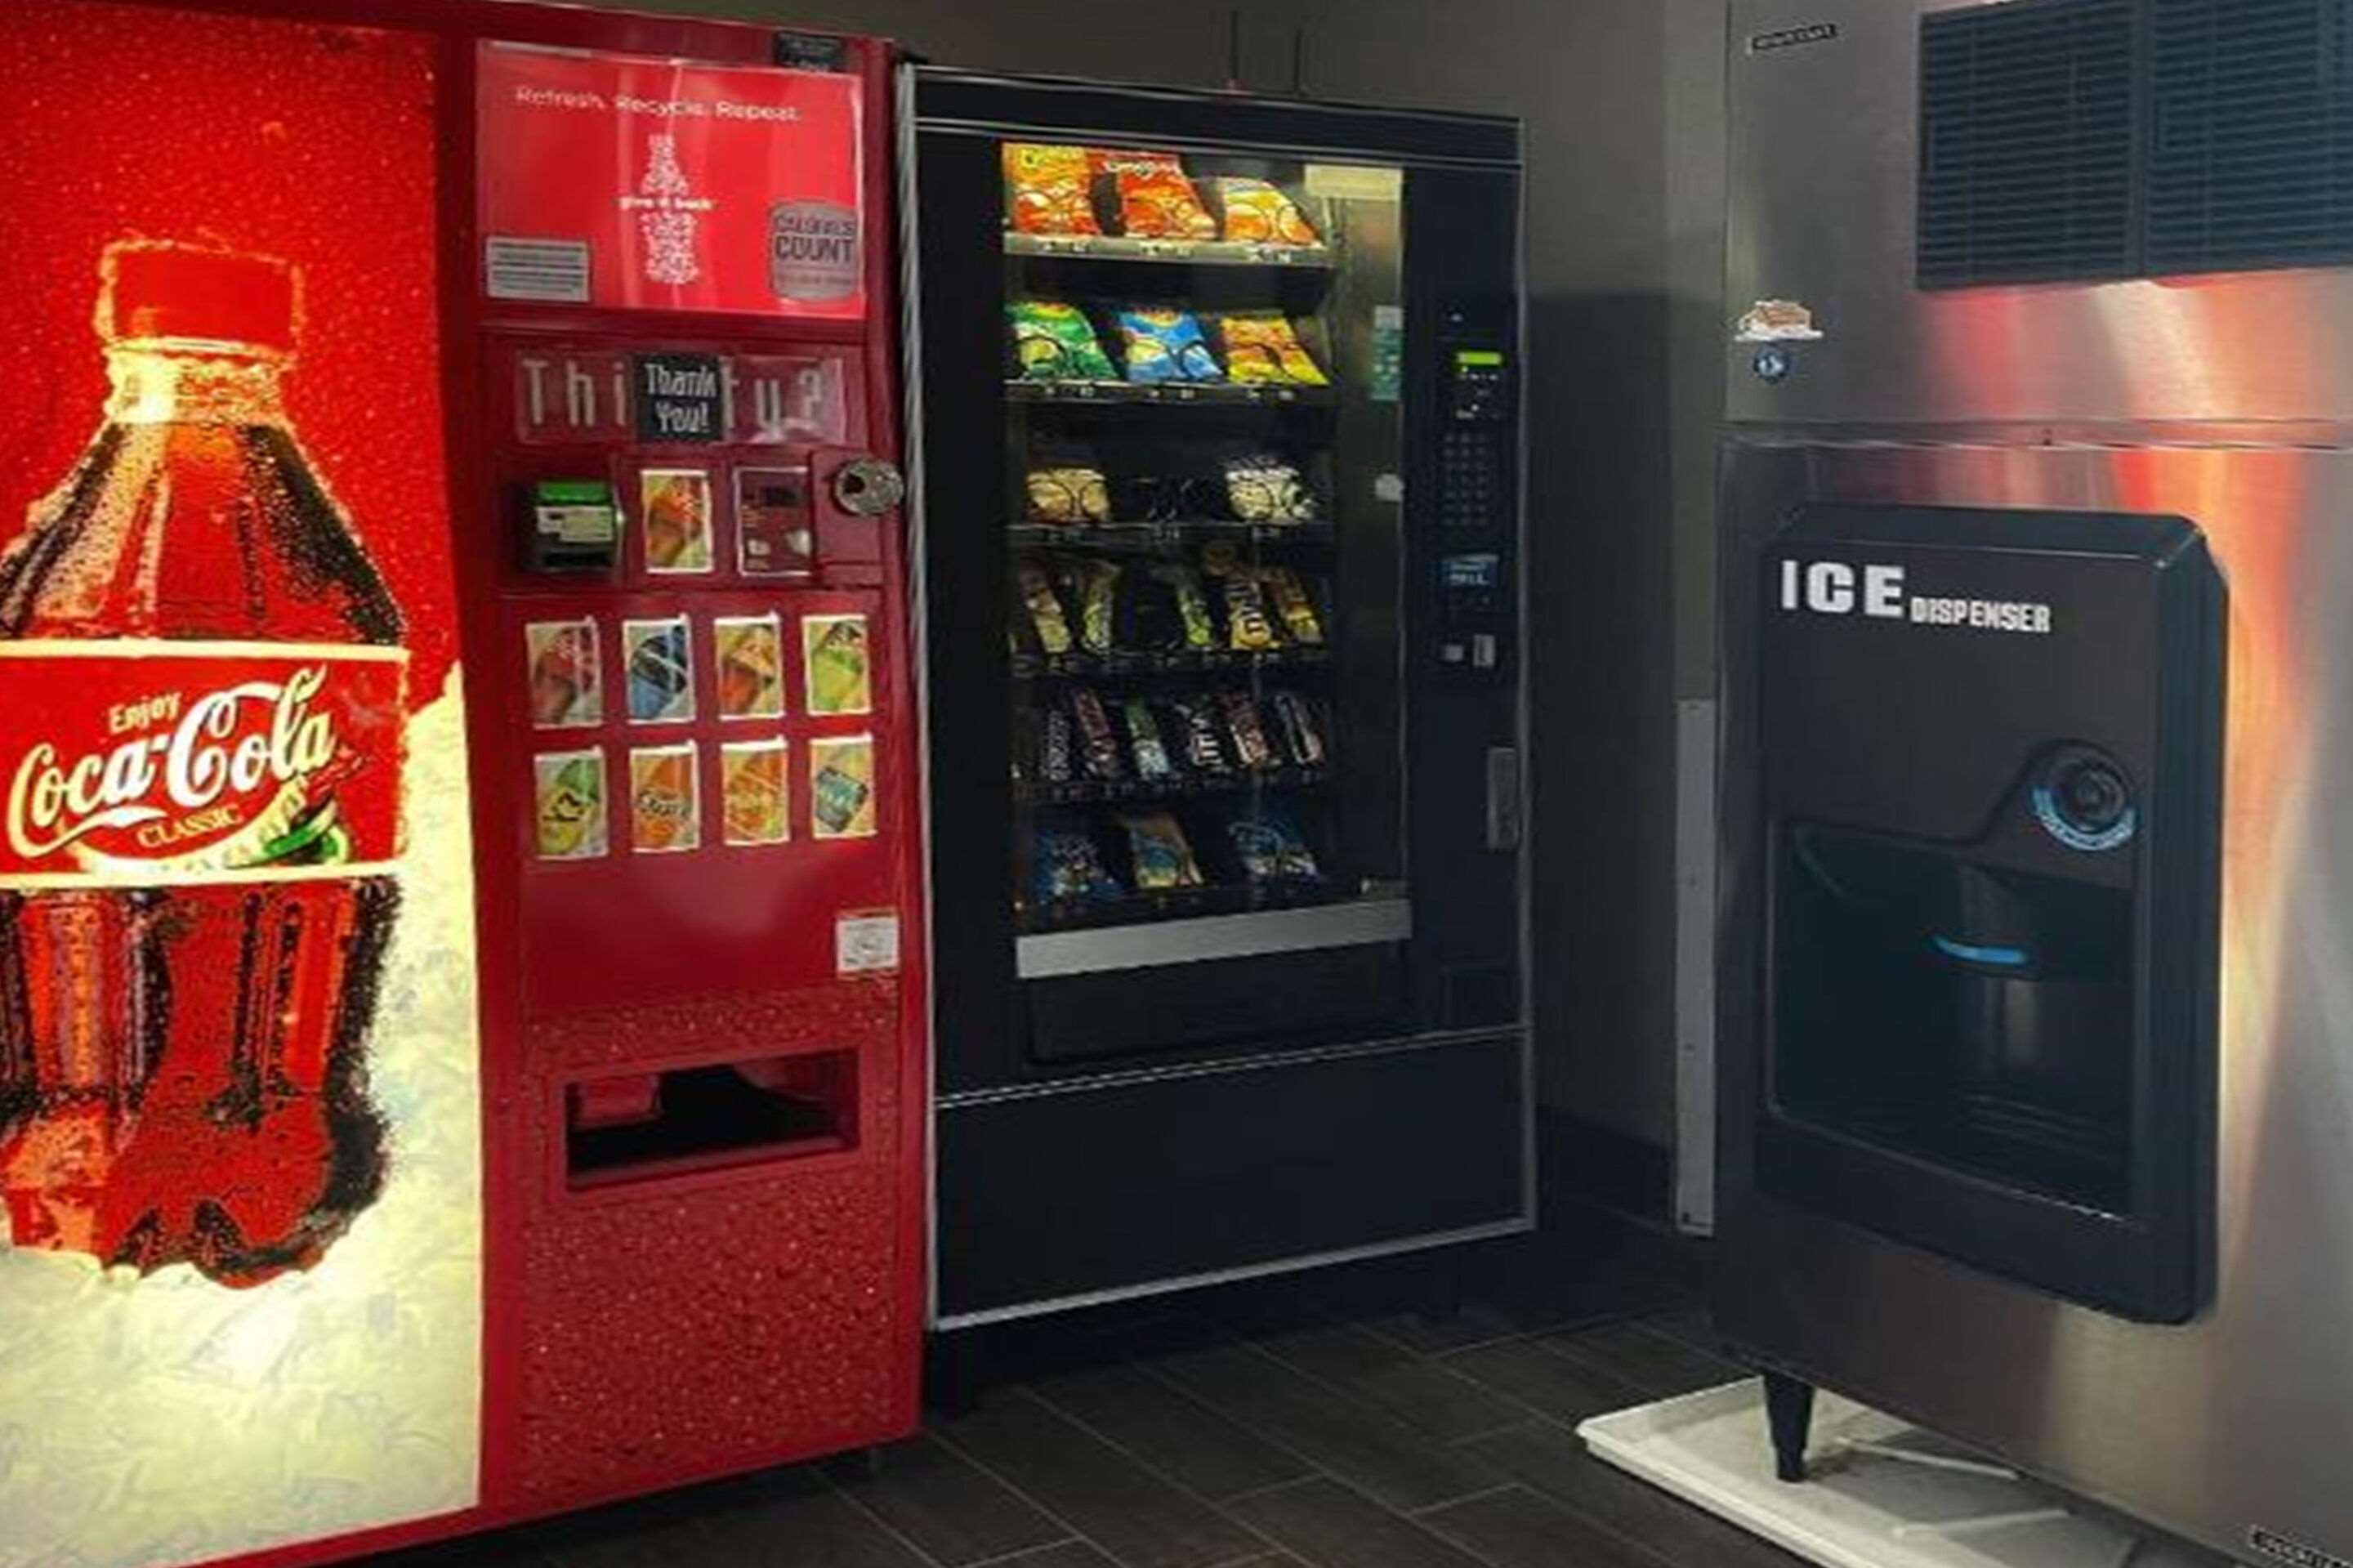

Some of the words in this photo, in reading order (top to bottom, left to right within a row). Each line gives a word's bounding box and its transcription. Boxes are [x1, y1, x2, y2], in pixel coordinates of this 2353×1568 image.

[775, 234, 853, 264] COUNT
[645, 362, 717, 399] Thank
[655, 401, 710, 433] You!
[1781, 559, 1905, 619] ICE
[1910, 596, 2052, 633] DISPENSER
[108, 691, 181, 734] Enjoy
[7, 663, 337, 859] Coca-Cola
[137, 803, 244, 848] CLASSIC
